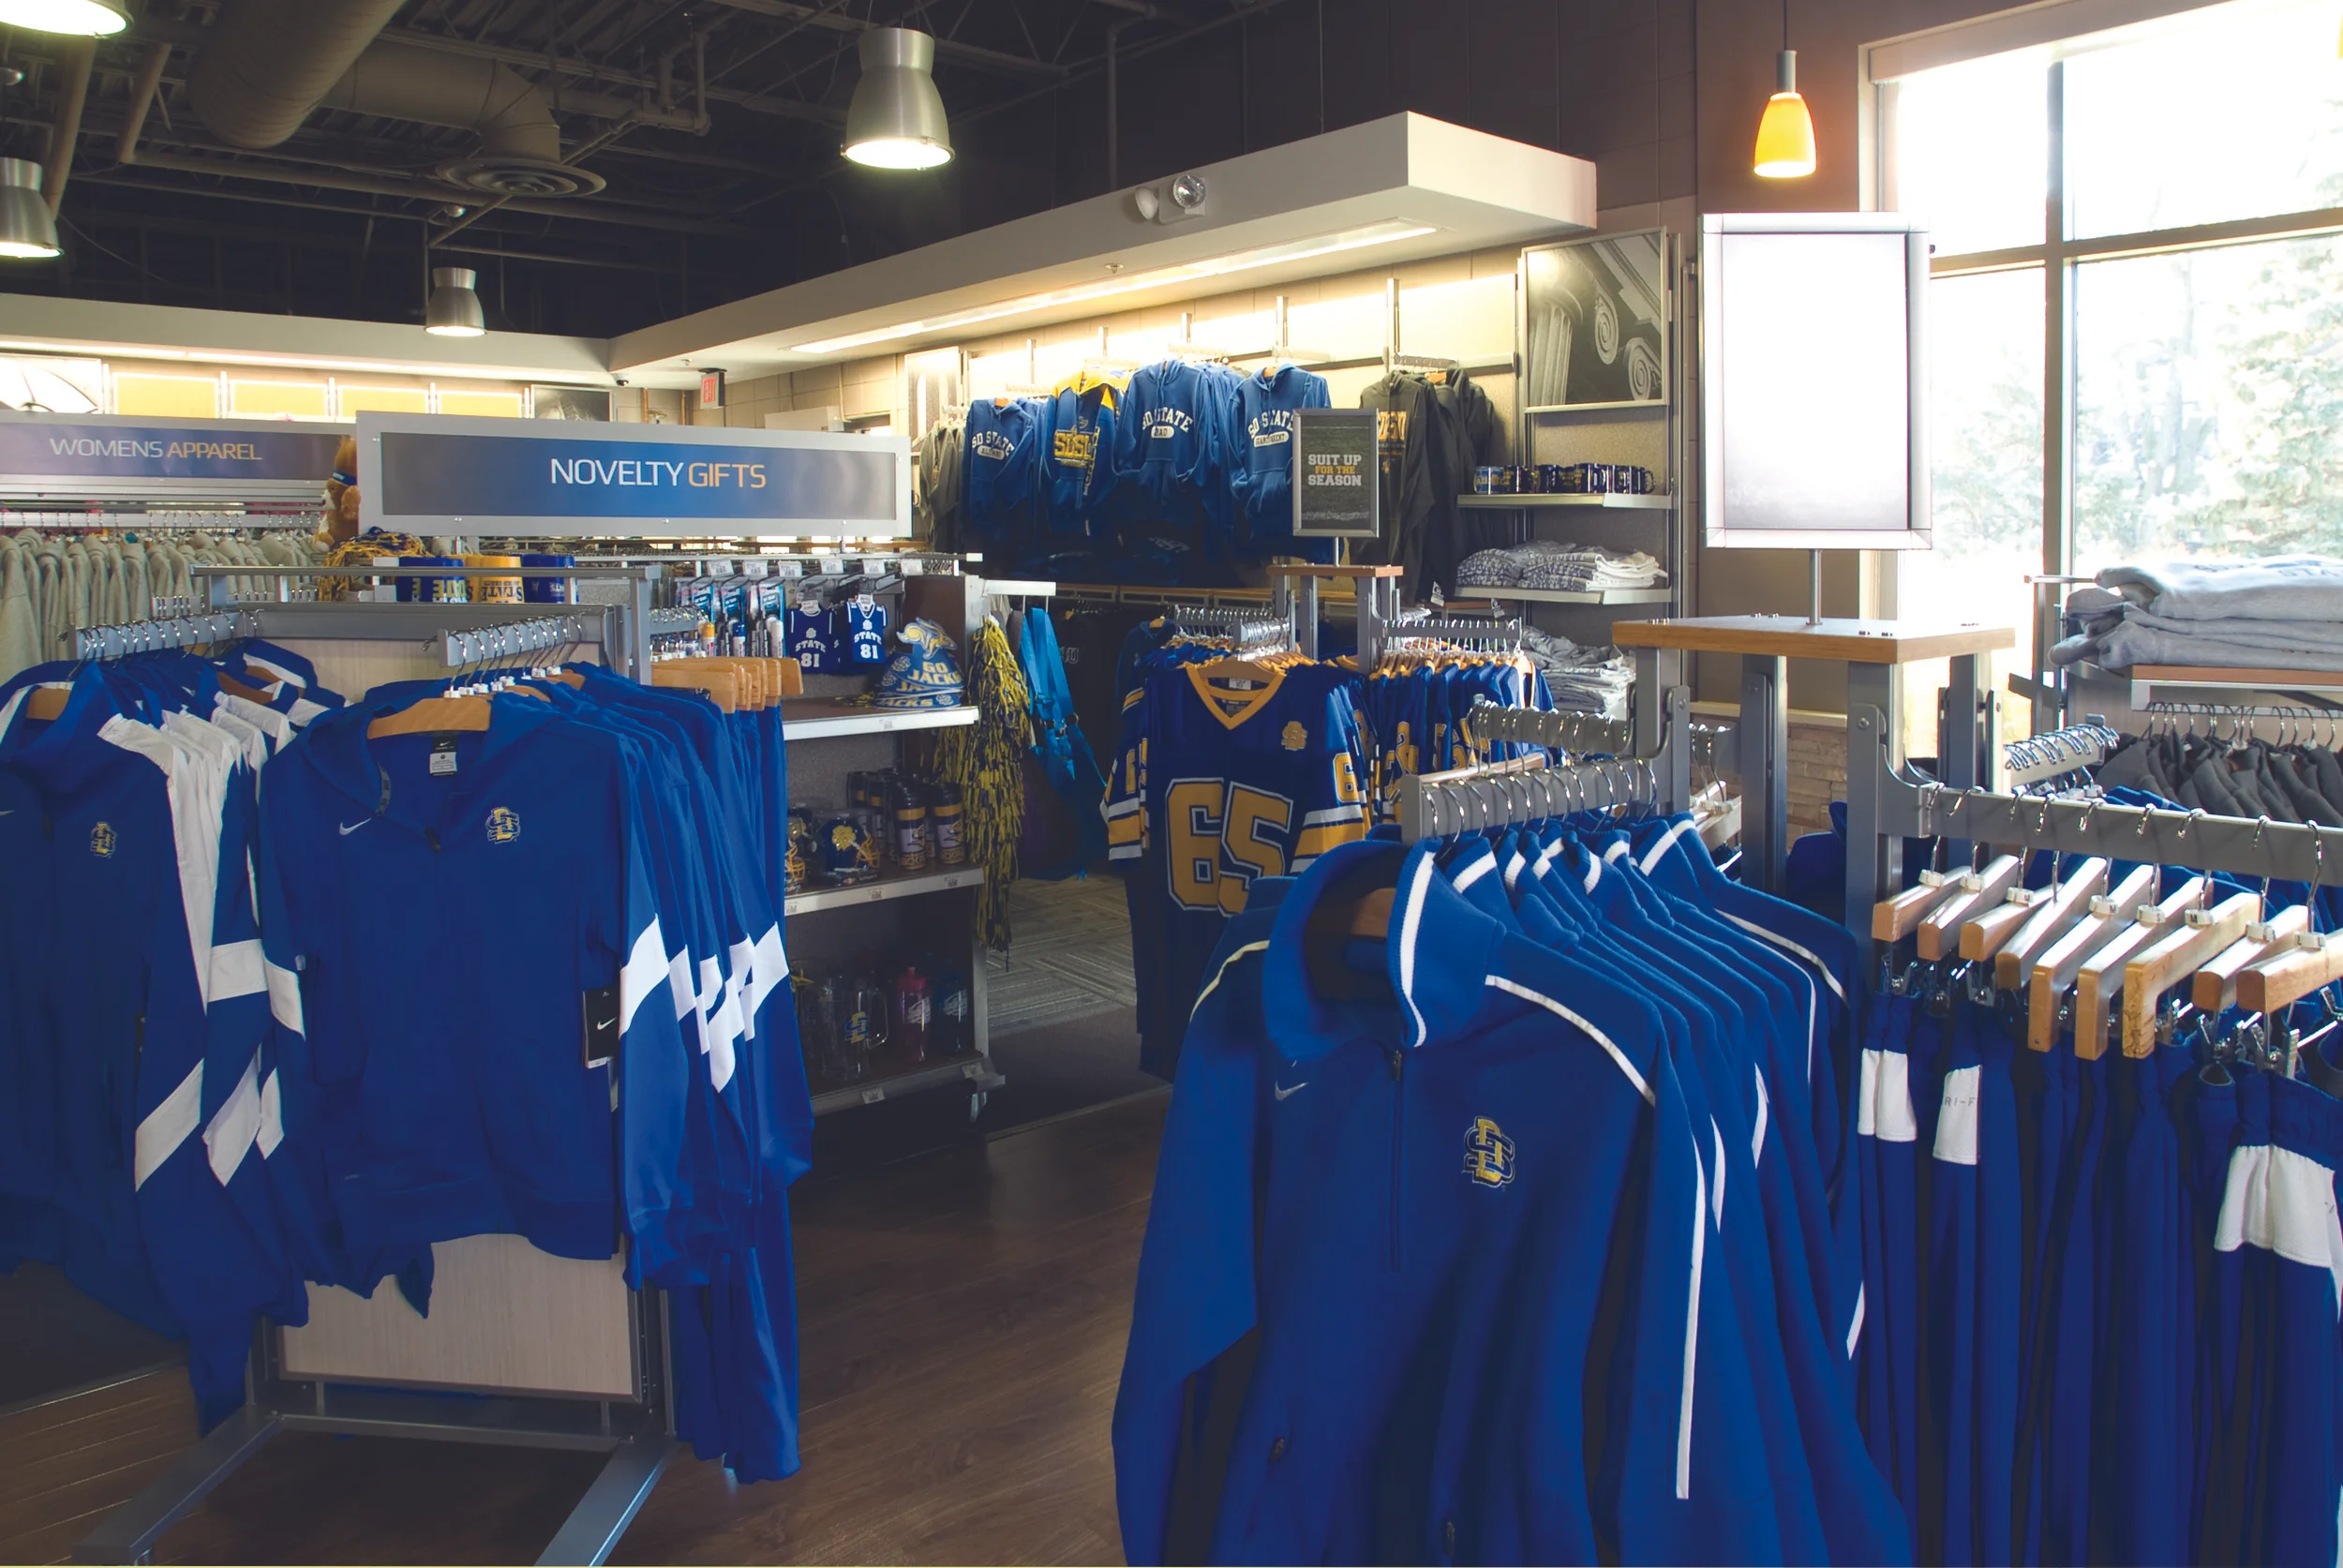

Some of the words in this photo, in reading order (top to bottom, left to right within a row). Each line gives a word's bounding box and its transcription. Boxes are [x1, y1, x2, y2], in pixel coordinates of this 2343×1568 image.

[1155, 407, 1193, 432] STATE
[1154, 428, 1168, 437] DAD
[50, 439, 163, 458] WOMENS
[167, 441, 262, 460] APPAREL
[972, 432, 983, 448] SD
[986, 431, 1015, 456] STATE
[1307, 454, 1340, 466] SUIT
[1343, 455, 1362, 466] UP
[550, 458, 684, 486] NOVELTY
[688, 462, 767, 488] GIFTS
[1315, 465, 1334, 474] FOR
[1336, 465, 1355, 474] THE
[1307, 474, 1362, 485] SEASON
[854, 631, 882, 645] STATE
[796, 639, 826, 652] STATE
[860, 643, 879, 659] 81
[800, 652, 820, 667] 81
[922, 661, 948, 673] GO
[1166, 777, 1293, 918] 65
